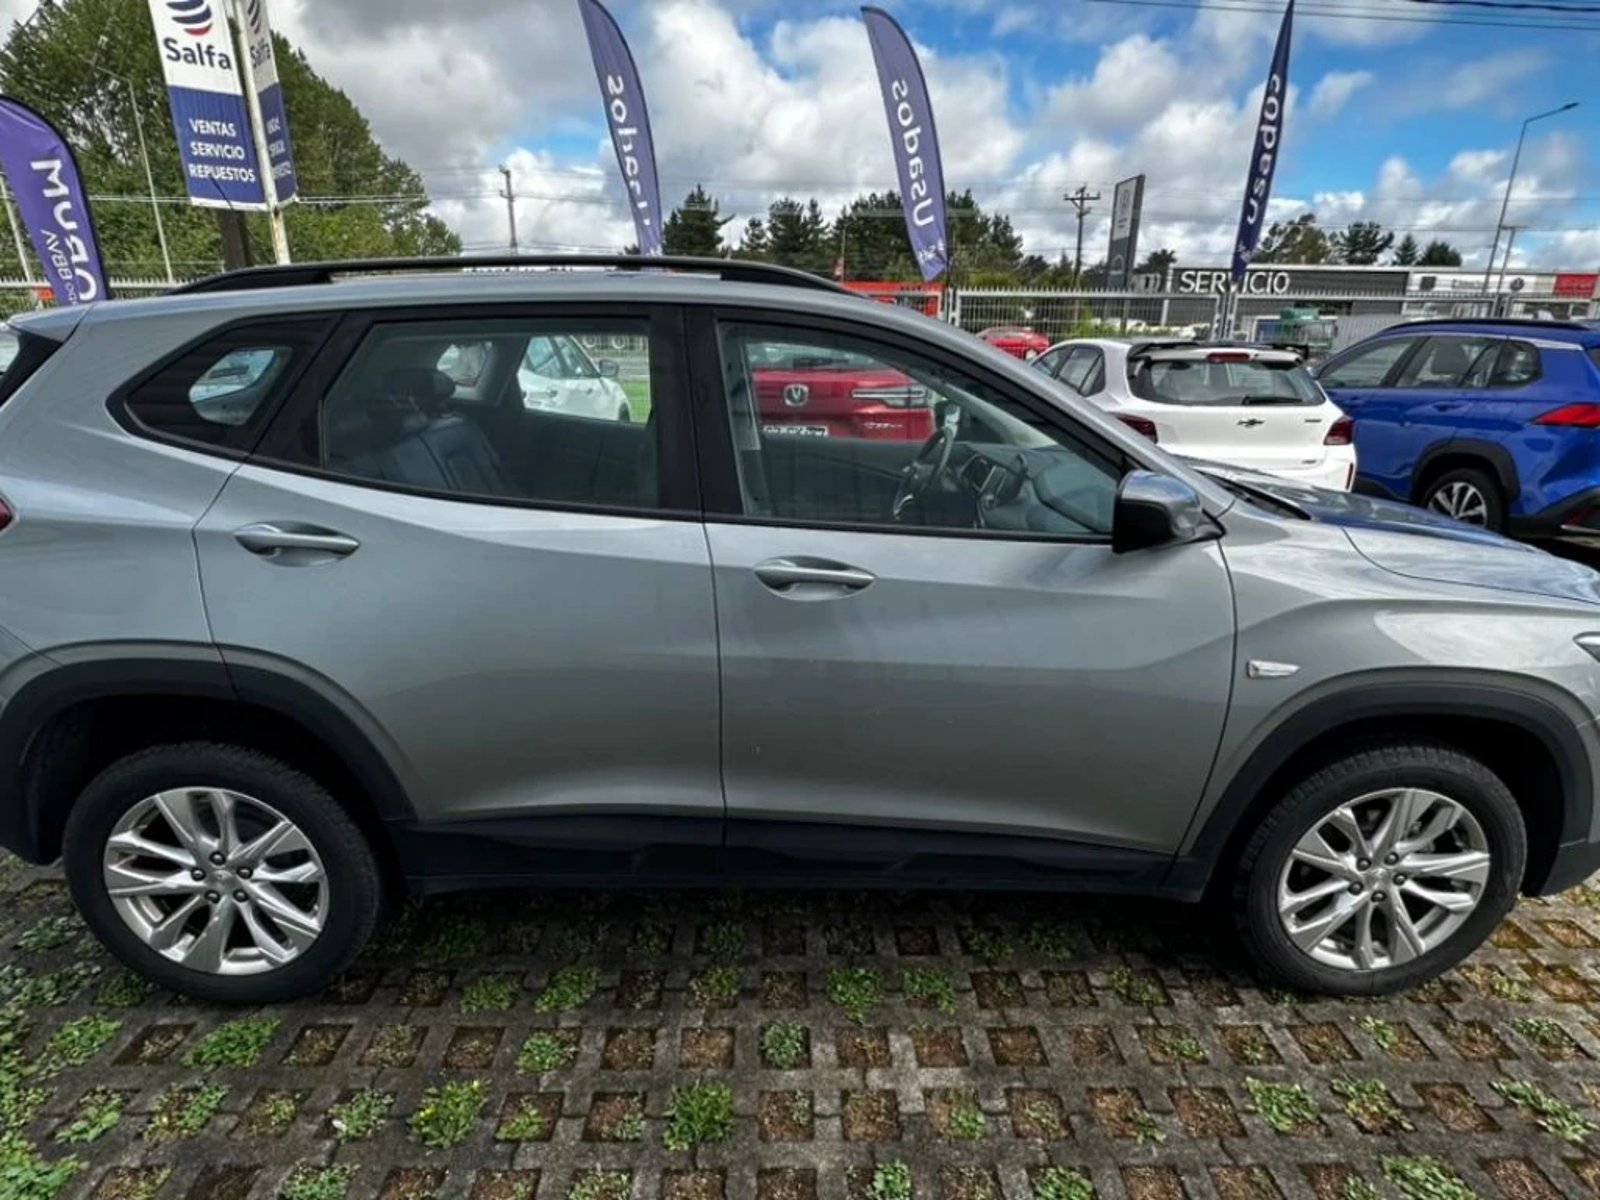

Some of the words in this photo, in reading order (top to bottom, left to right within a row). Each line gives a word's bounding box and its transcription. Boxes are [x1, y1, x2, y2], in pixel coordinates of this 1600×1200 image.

[162, 37, 233, 70] Salfa
[189, 118, 237, 138] VENTAS
[190, 141, 245, 160] SERVICIO
[188, 163, 256, 183] REPUESTOS
